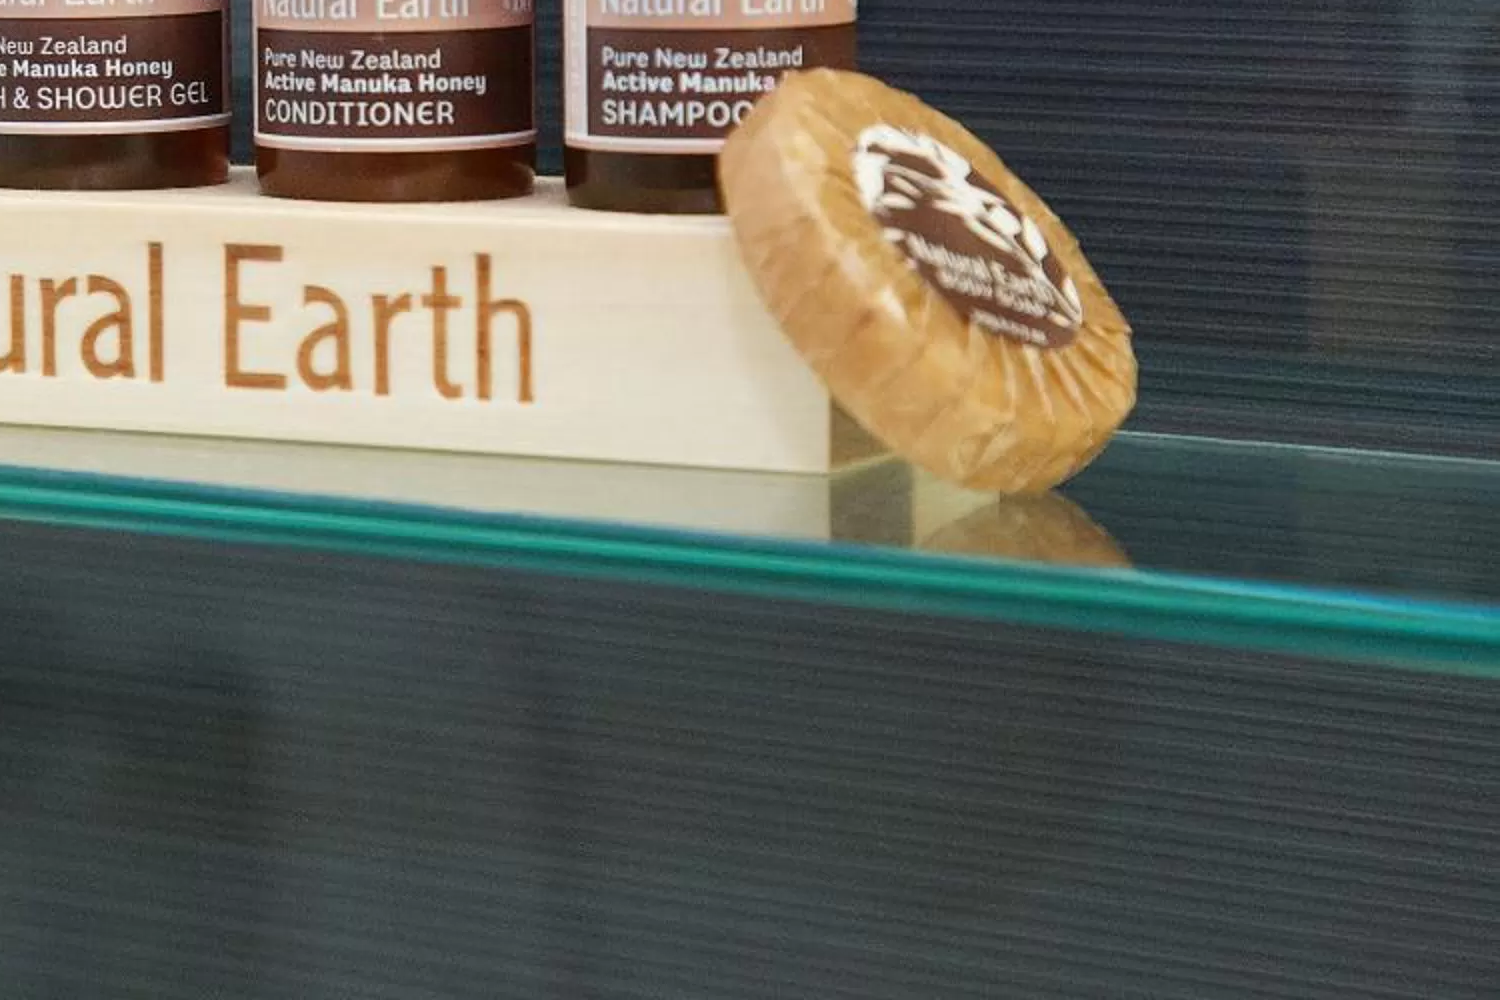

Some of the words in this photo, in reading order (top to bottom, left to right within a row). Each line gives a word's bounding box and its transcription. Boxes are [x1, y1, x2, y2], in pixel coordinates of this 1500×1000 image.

[40, 34, 126, 55] Zealand
[265, 47, 296, 67] Pure
[301, 50, 344, 69] New
[351, 48, 441, 70] Zealand
[602, 45, 648, 68] Pure
[655, 48, 707, 69] New
[715, 45, 803, 69] Zealand
[13, 60, 97, 78] Manuka
[105, 60, 173, 78] Honey
[265, 72, 316, 91] Active
[322, 73, 412, 93] Manuka
[418, 73, 487, 95] Honey
[603, 70, 673, 92] Active
[680, 71, 776, 93] Manuka
[13, 87, 30, 109] &
[37, 84, 162, 109] SHOWER
[170, 82, 208, 105] GEL
[265, 98, 454, 126] CONDITIONER
[223, 243, 534, 403] Earth
